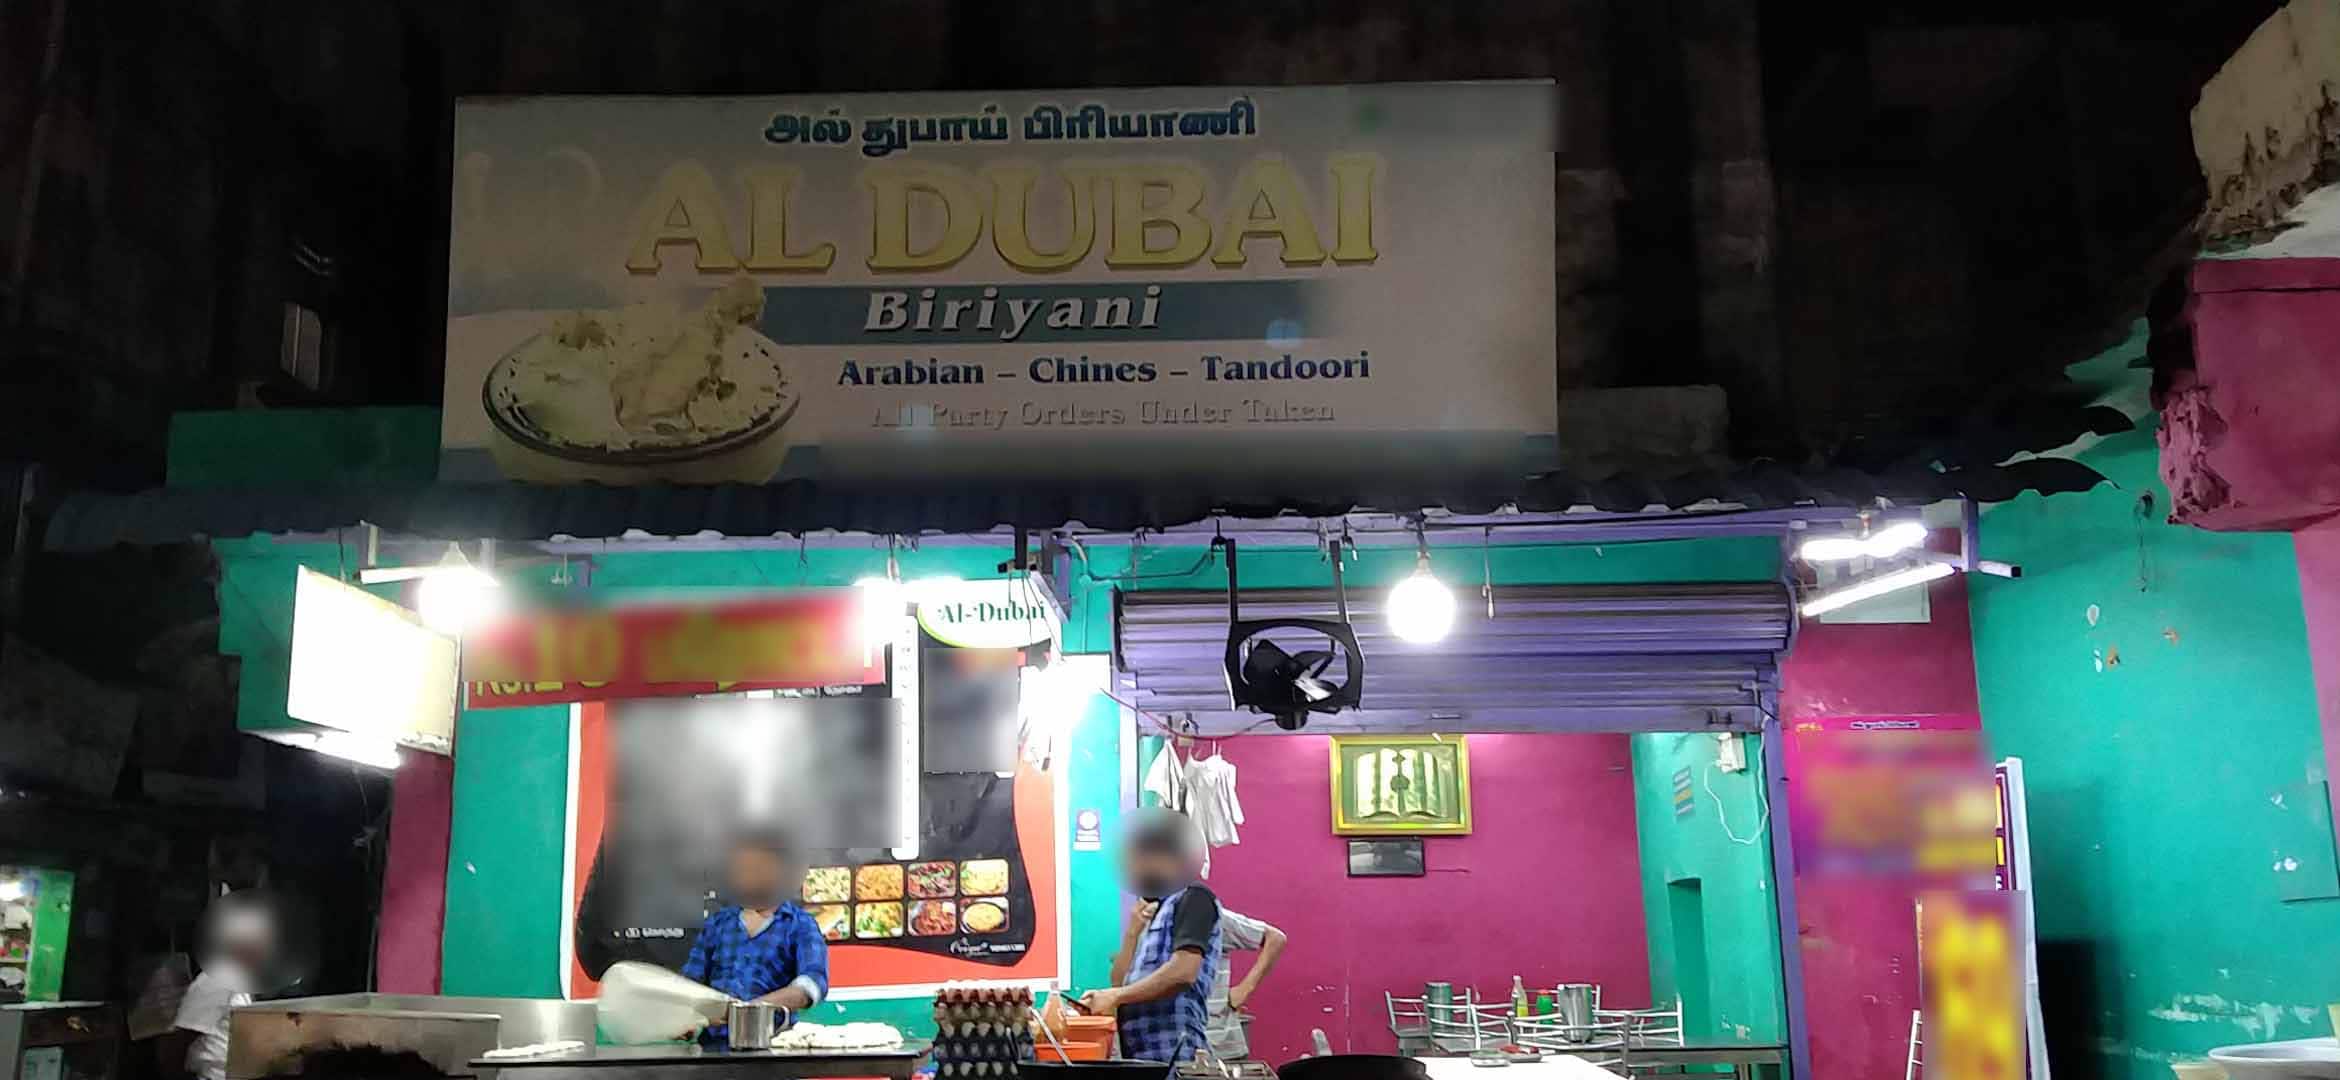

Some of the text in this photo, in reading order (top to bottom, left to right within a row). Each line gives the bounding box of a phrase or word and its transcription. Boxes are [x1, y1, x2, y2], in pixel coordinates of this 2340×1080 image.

[764, 96, 1256, 157] அல் துபாய் பிரியாணி
[625, 154, 1379, 276] AL DUBAI
[863, 286, 1163, 342] Biriyani
[837, 358, 985, 387] Arabian
[1028, 355, 1158, 385] Chines
[1200, 350, 1371, 383] Tandoori
[927, 401, 1008, 431] Party
[1019, 400, 1127, 427] Orders
[1138, 399, 1233, 425] Under
[938, 599, 1046, 624] Al-Dubai
